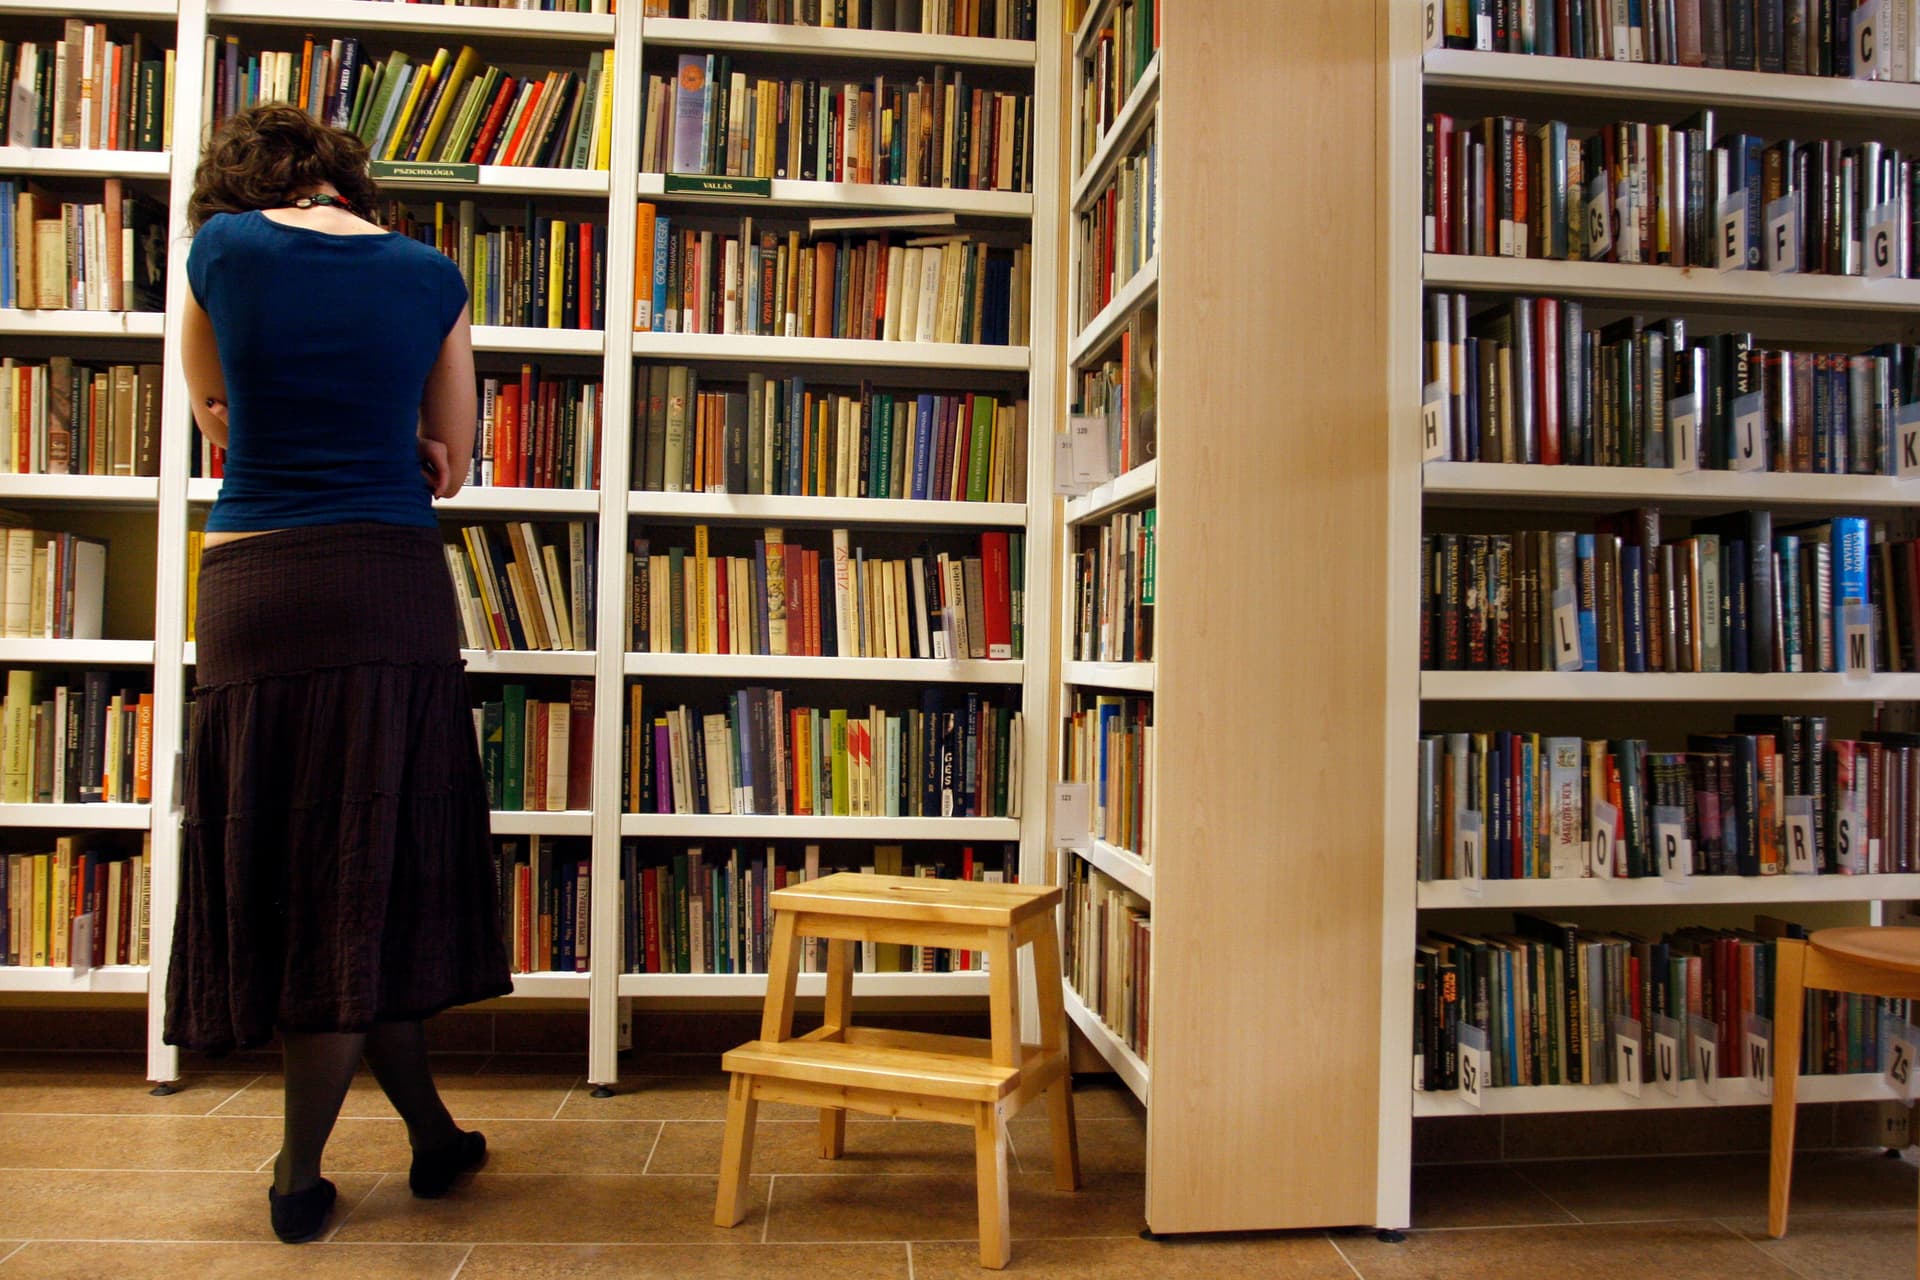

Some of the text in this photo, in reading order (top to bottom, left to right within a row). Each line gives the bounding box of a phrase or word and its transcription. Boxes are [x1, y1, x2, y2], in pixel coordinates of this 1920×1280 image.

[1426, 2, 1434, 40] B
[1860, 26, 1872, 62] C
[848, 98, 857, 131] Mohamed
[393, 167, 454, 176] PSZICHOLÓGIA
[1516, 135, 1524, 190] NAPVIHAR
[704, 181, 732, 190] VALLÁS
[1589, 207, 1604, 243] Cs
[1725, 220, 1736, 258] E
[1776, 223, 1786, 262] F
[1874, 231, 1888, 267] G
[1737, 343, 1748, 393] MIDAS
[1425, 411, 1437, 449] H
[1743, 422, 1753, 458] J
[1904, 431, 1917, 468] K
[837, 547, 848, 591] ZEUSZ
[952, 564, 962, 607] Szeretlek
[1560, 616, 1571, 652] L
[1851, 633, 1866, 669] M
[1597, 828, 1607, 865] O
[1666, 834, 1677, 870] P
[1793, 825, 1806, 861] R
[1838, 819, 1850, 855] S
[1464, 840, 1473, 878] N
[1448, 971, 1456, 1001] WARS
[1462, 1055, 1477, 1095] Sz
[1623, 1045, 1633, 1082] T
[1660, 1043, 1671, 1082] U
[1700, 1046, 1711, 1085] V
[1751, 1043, 1765, 1082] W
[1890, 1044, 1908, 1086] Zs
